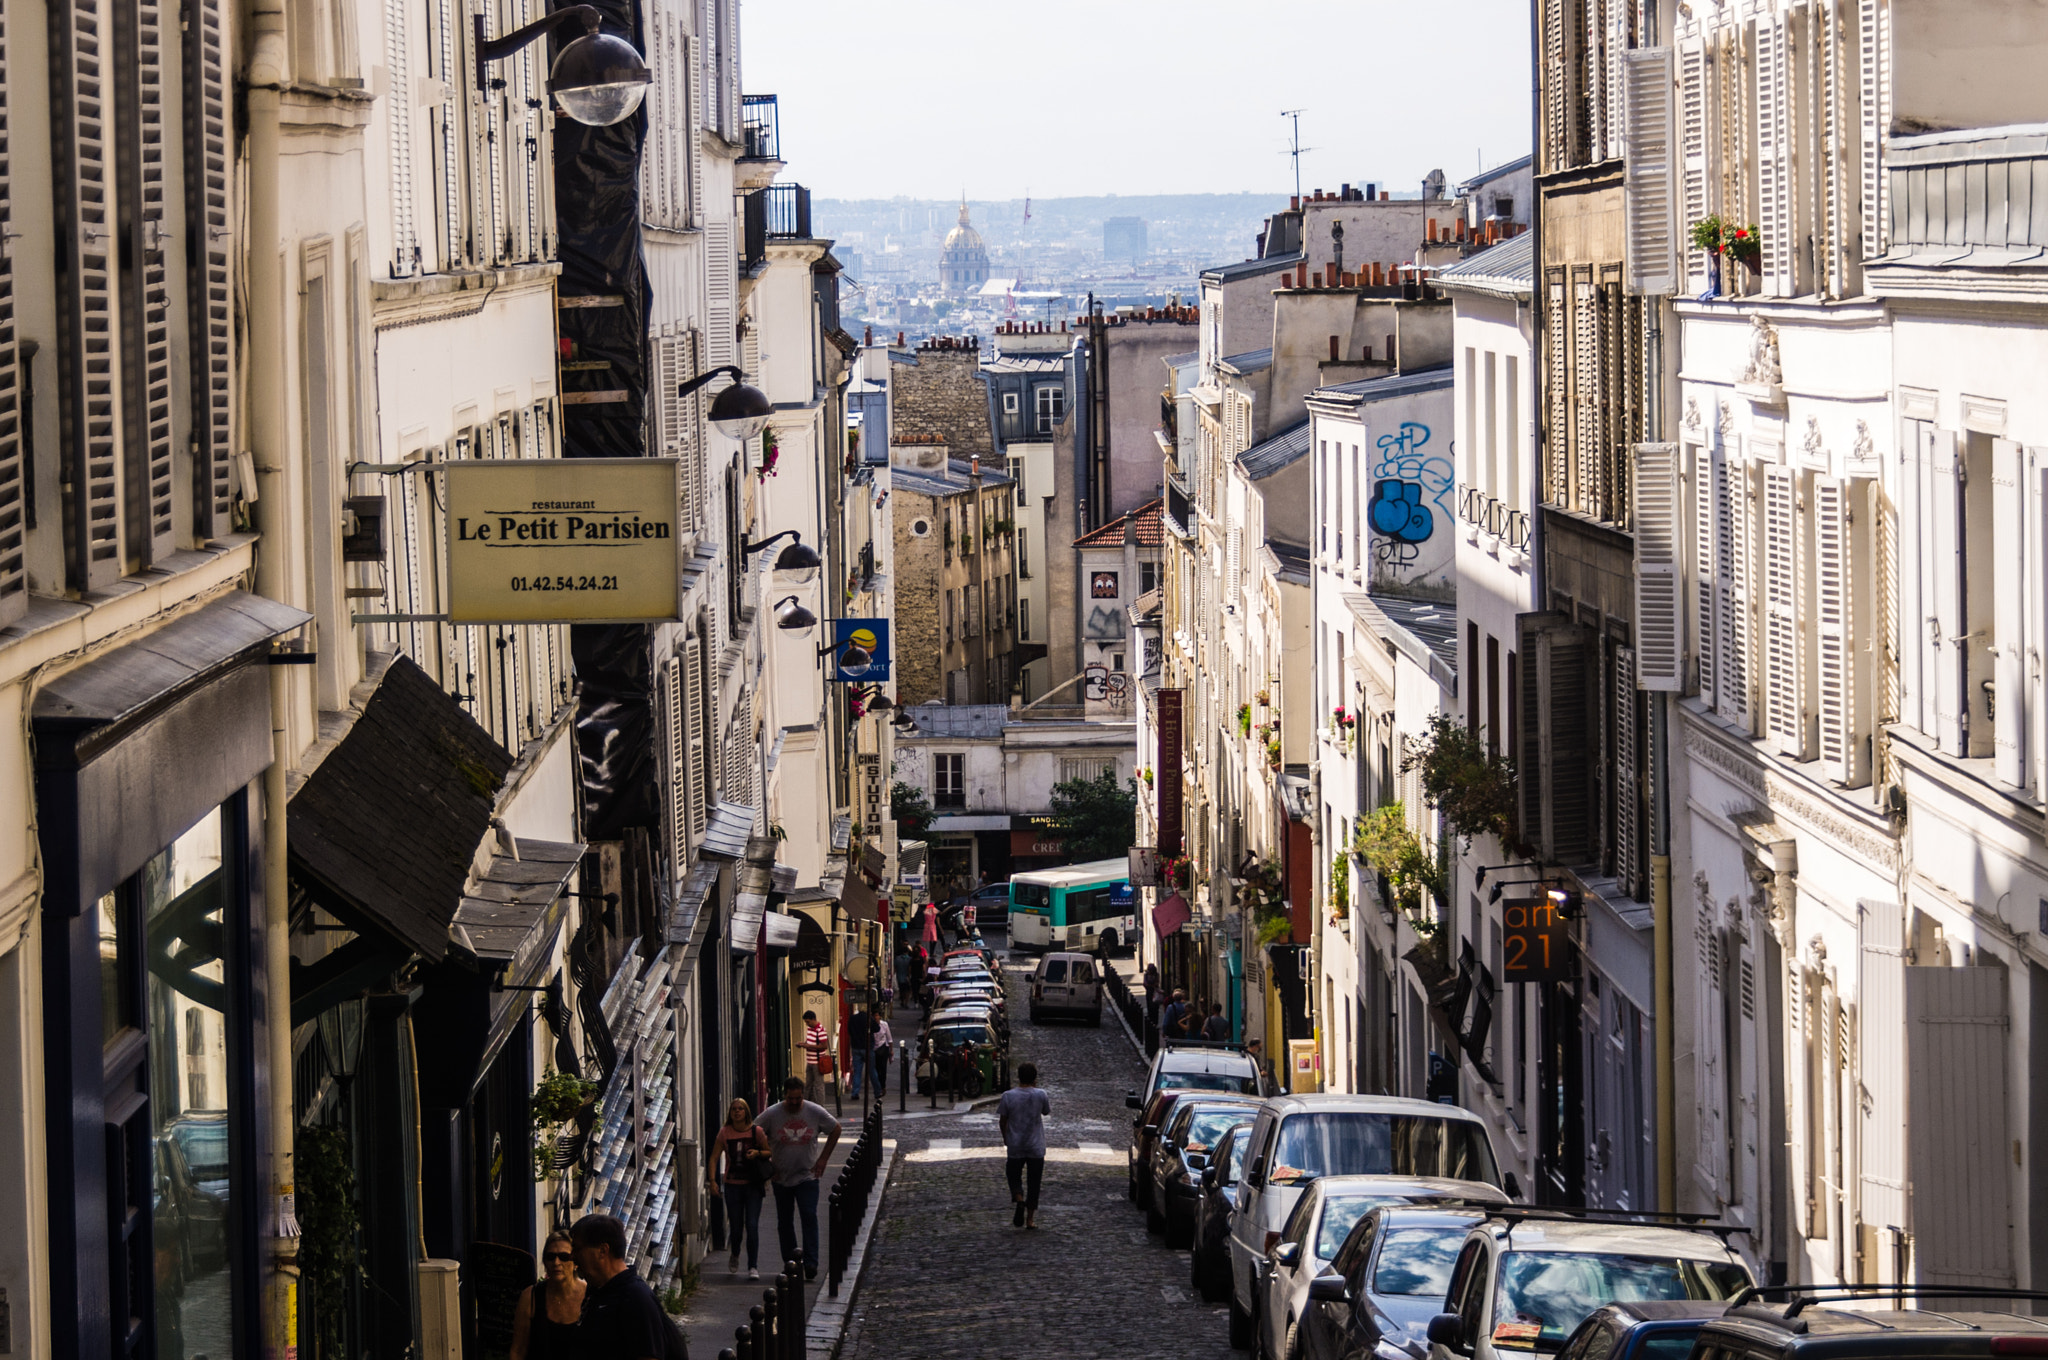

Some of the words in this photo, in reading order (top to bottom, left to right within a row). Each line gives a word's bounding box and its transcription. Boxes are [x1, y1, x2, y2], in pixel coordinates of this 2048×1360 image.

[531, 499, 596, 510] restaurant
[457, 518, 491, 541] Le
[498, 516, 559, 540] Petit
[566, 516, 671, 540] Parisien
[511, 575, 619, 591] 01.42.54.24.21
[1165, 696, 1177, 716] LES
[858, 754, 880, 764] CINE
[867, 766, 880, 823] STUDIO
[1165, 768, 1178, 822] PREMIUM
[867, 825, 882, 835] 28
[1504, 899, 1555, 929] art
[1504, 934, 1551, 970] 21
[1433, 1061, 1443, 1075] P
